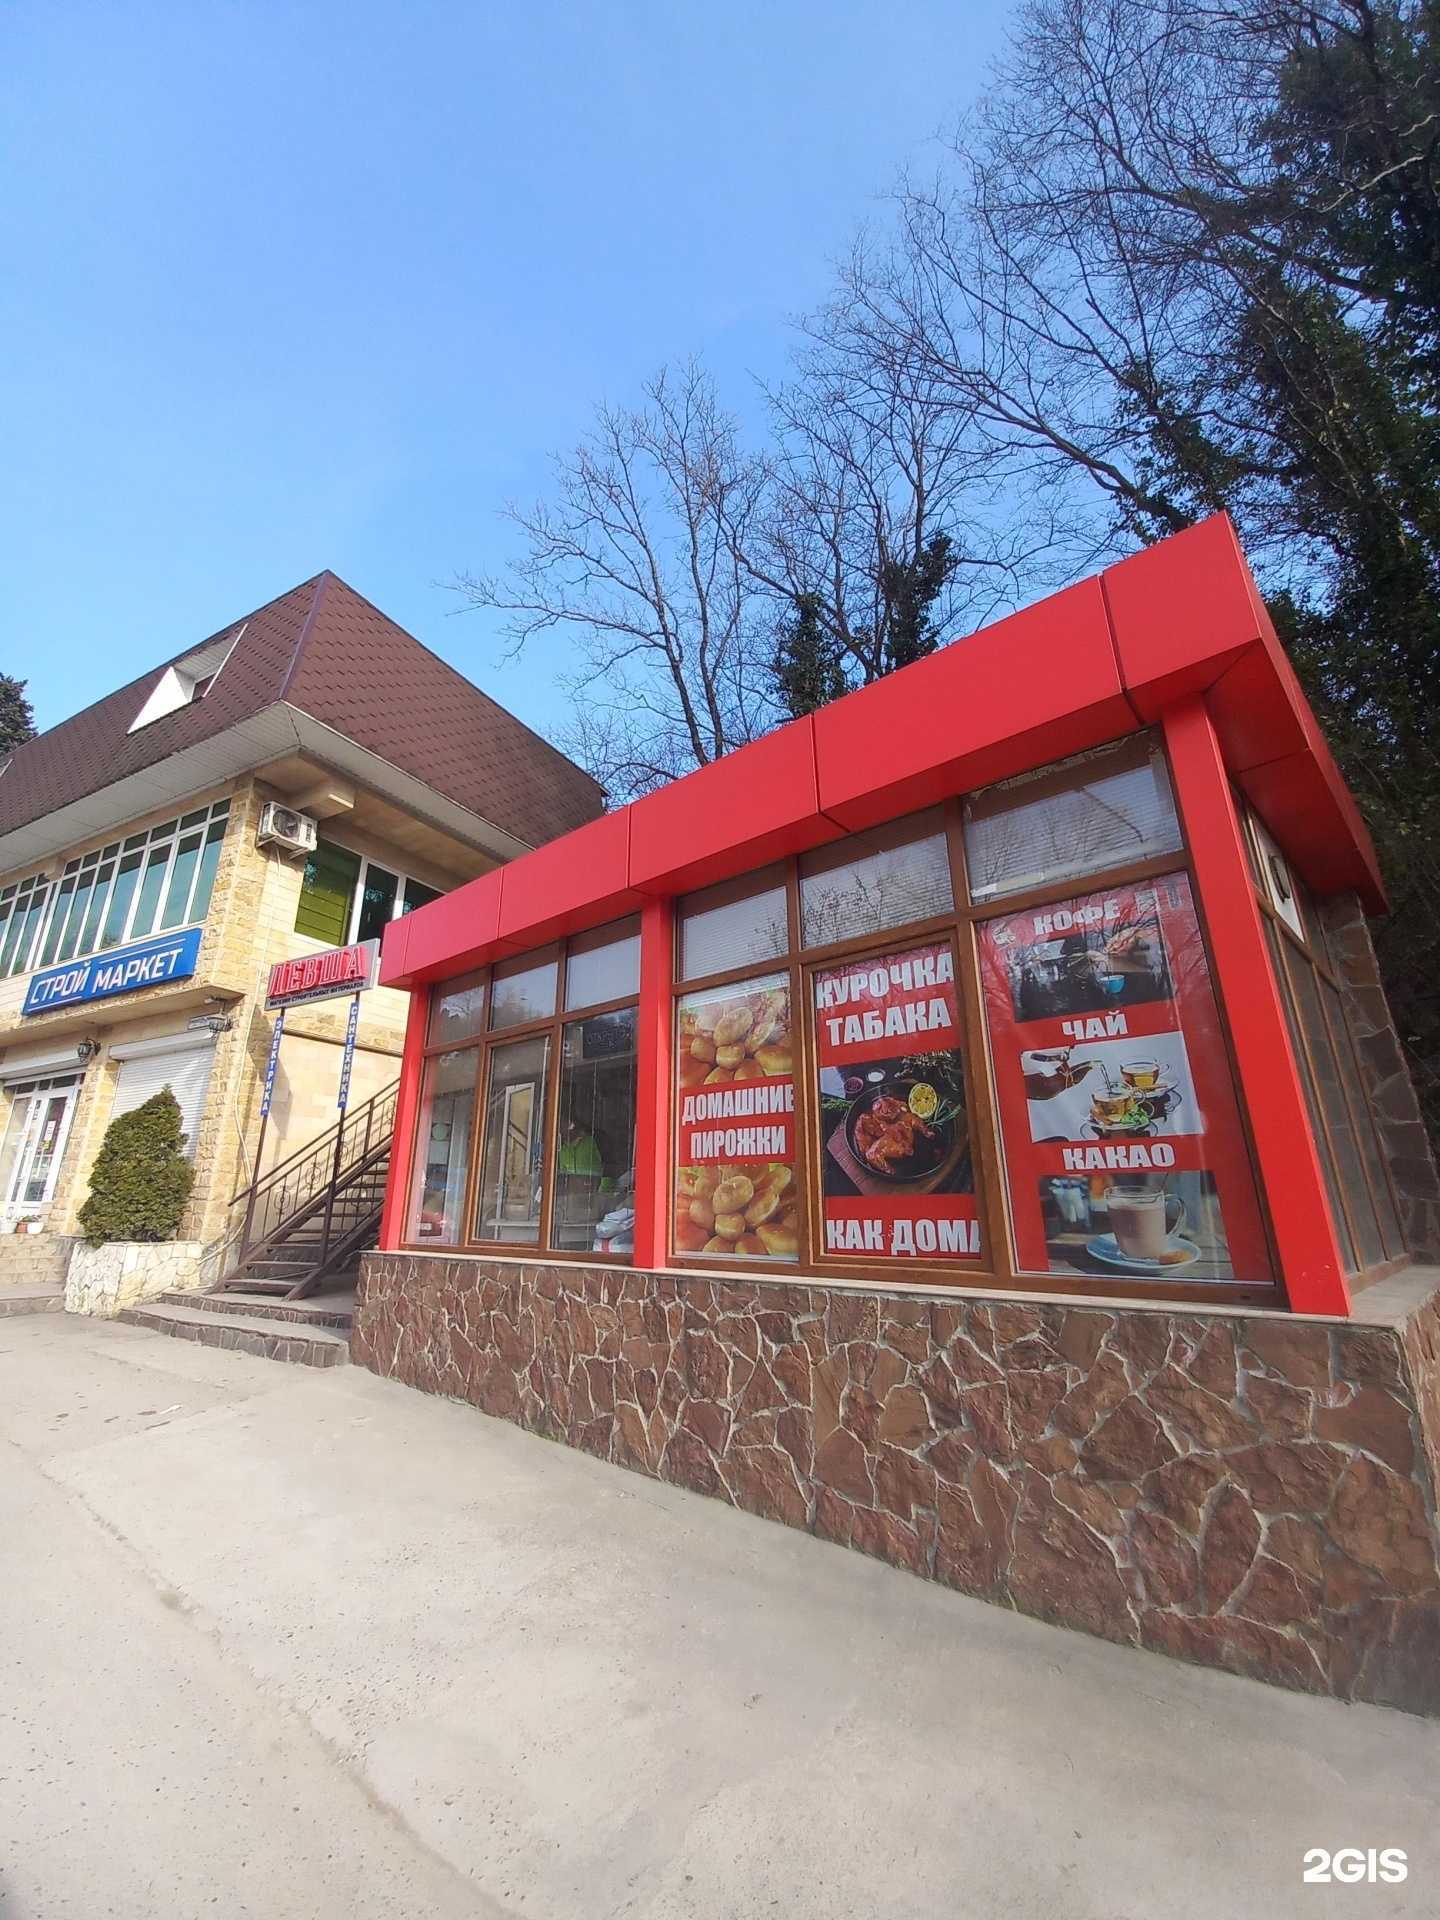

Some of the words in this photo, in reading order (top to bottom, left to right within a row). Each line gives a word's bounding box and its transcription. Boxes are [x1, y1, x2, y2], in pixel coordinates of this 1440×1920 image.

[1033, 899, 1121, 936] КОФЕ
[30, 960, 92, 1004] СТРОЙ
[92, 948, 183, 993] МАРКЕТ
[268, 945, 367, 997] ЛЕВША
[817, 952, 954, 1009] КУРОЧКА
[826, 997, 952, 1047] ТАБАКА
[1062, 1009, 1128, 1041] ЧАЙ
[262, 1020, 282, 1110] ЭЛЕКТРИКА
[340, 1006, 358, 1102] САНТЕХНИКА
[682, 1083, 795, 1126] ДОМАШНИЕ
[690, 1125, 786, 1159] ПИРОЖКИ
[1062, 1143, 1176, 1170] КАКАО
[826, 1219, 884, 1250] КАК
